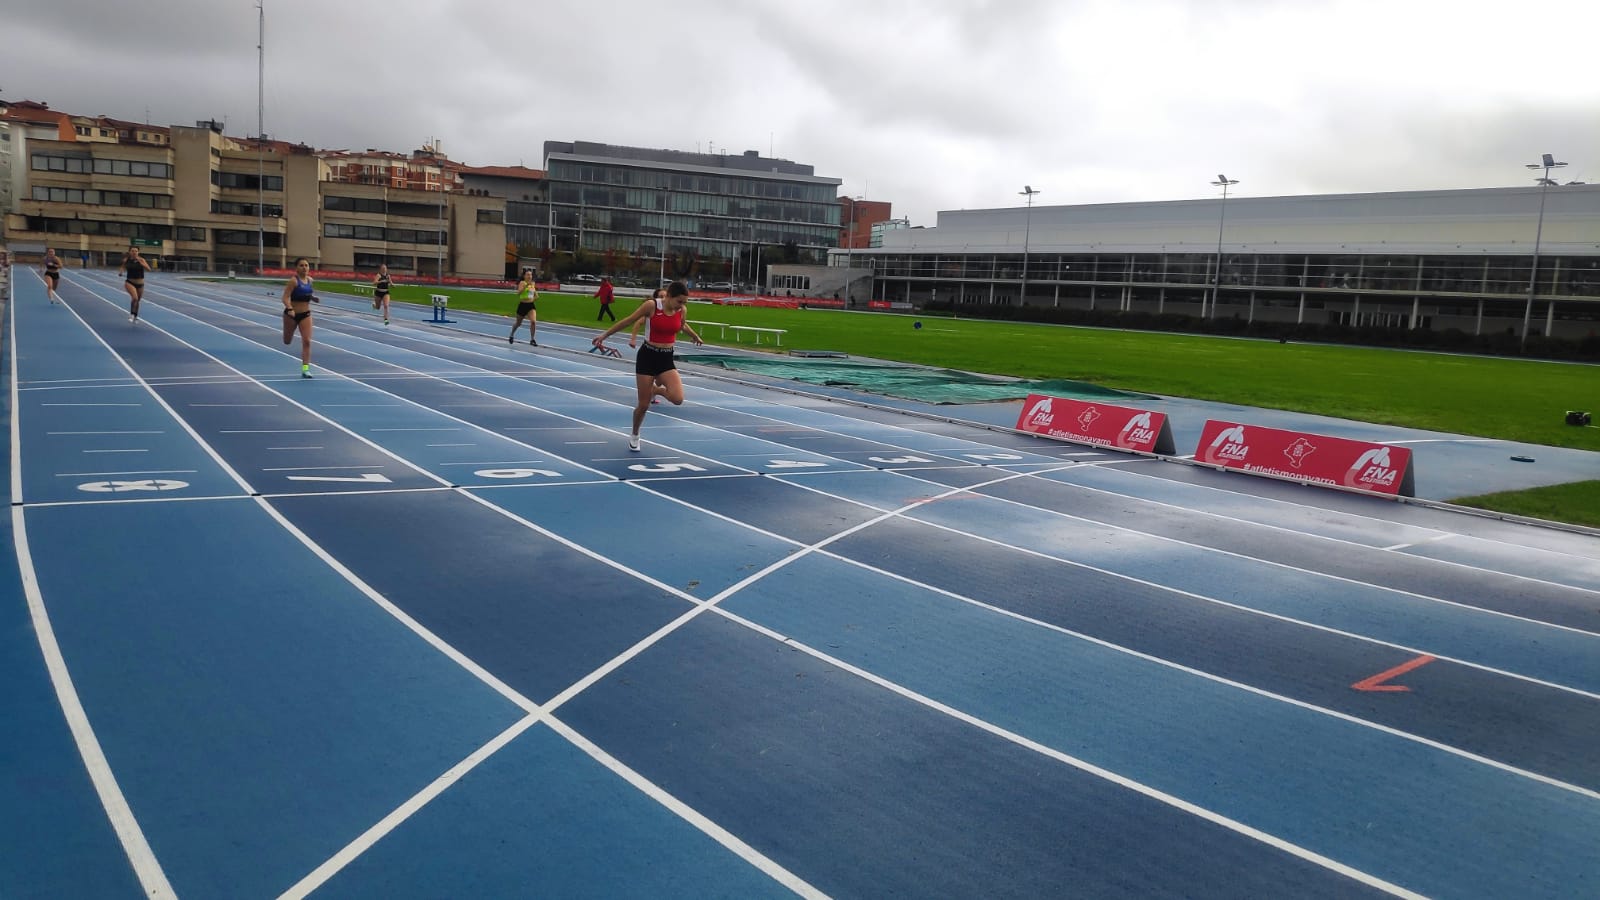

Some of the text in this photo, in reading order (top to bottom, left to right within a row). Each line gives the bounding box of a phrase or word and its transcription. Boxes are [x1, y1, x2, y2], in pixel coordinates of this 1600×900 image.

[1034, 412, 1054, 423] FNA
[1048, 428, 1112, 445] #atletismonavarro
[1131, 428, 1154, 439] FNA
[1221, 443, 1248, 457] FNA
[868, 455, 937, 464] 3
[961, 453, 1023, 461] 2
[627, 463, 708, 473] 5
[765, 459, 830, 469] 4
[286, 474, 393, 484] 7
[474, 468, 564, 479] 6
[1243, 463, 1336, 485] #atletismonavarro
[1363, 466, 1397, 481] FNA
[78, 480, 190, 492] 8
